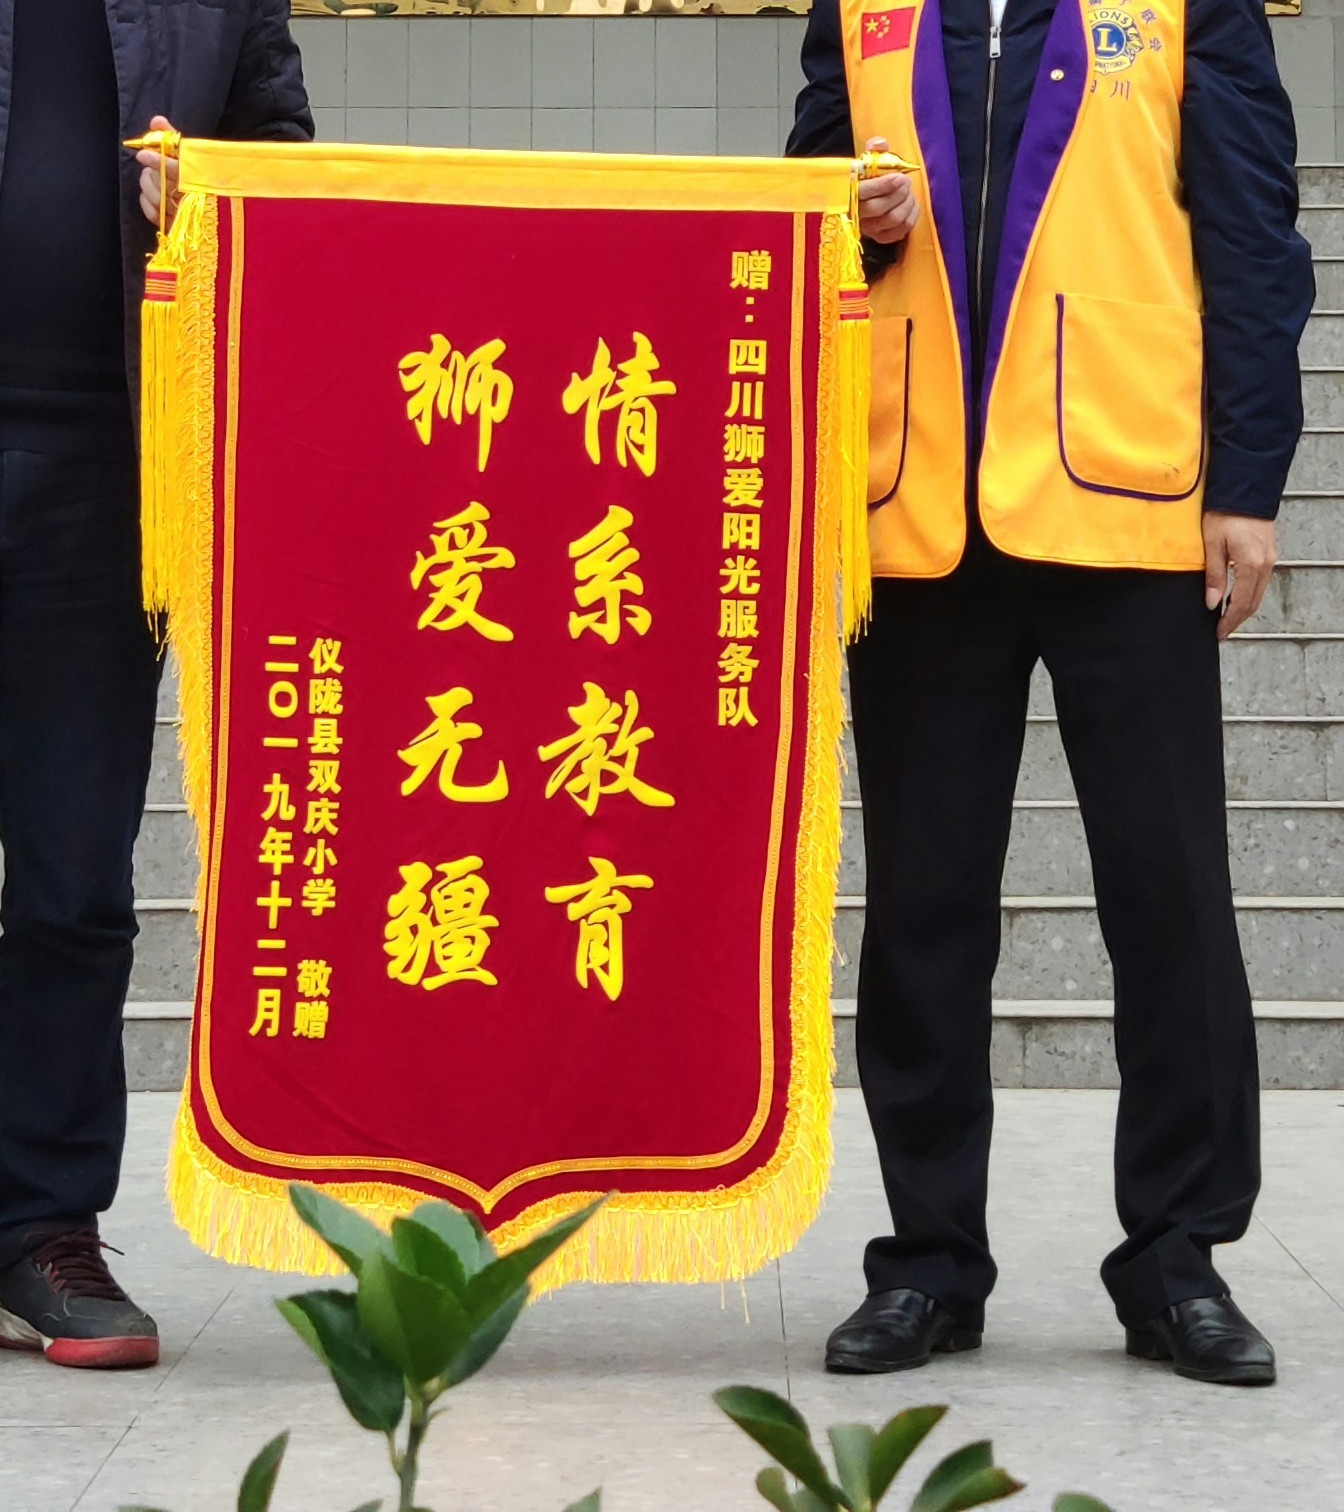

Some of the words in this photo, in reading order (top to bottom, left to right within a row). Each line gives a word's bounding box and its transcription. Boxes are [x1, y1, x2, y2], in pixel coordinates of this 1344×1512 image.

[1089, 10, 1130, 26] IONS
[1097, 28, 1117, 52] L
[382, 333, 516, 991] 狮爱无疆
[537, 332, 677, 1001] 情系教育
[301, 637, 344, 916] 仪陇县双庆小学
[292, 958, 332, 1039] 敬赠
